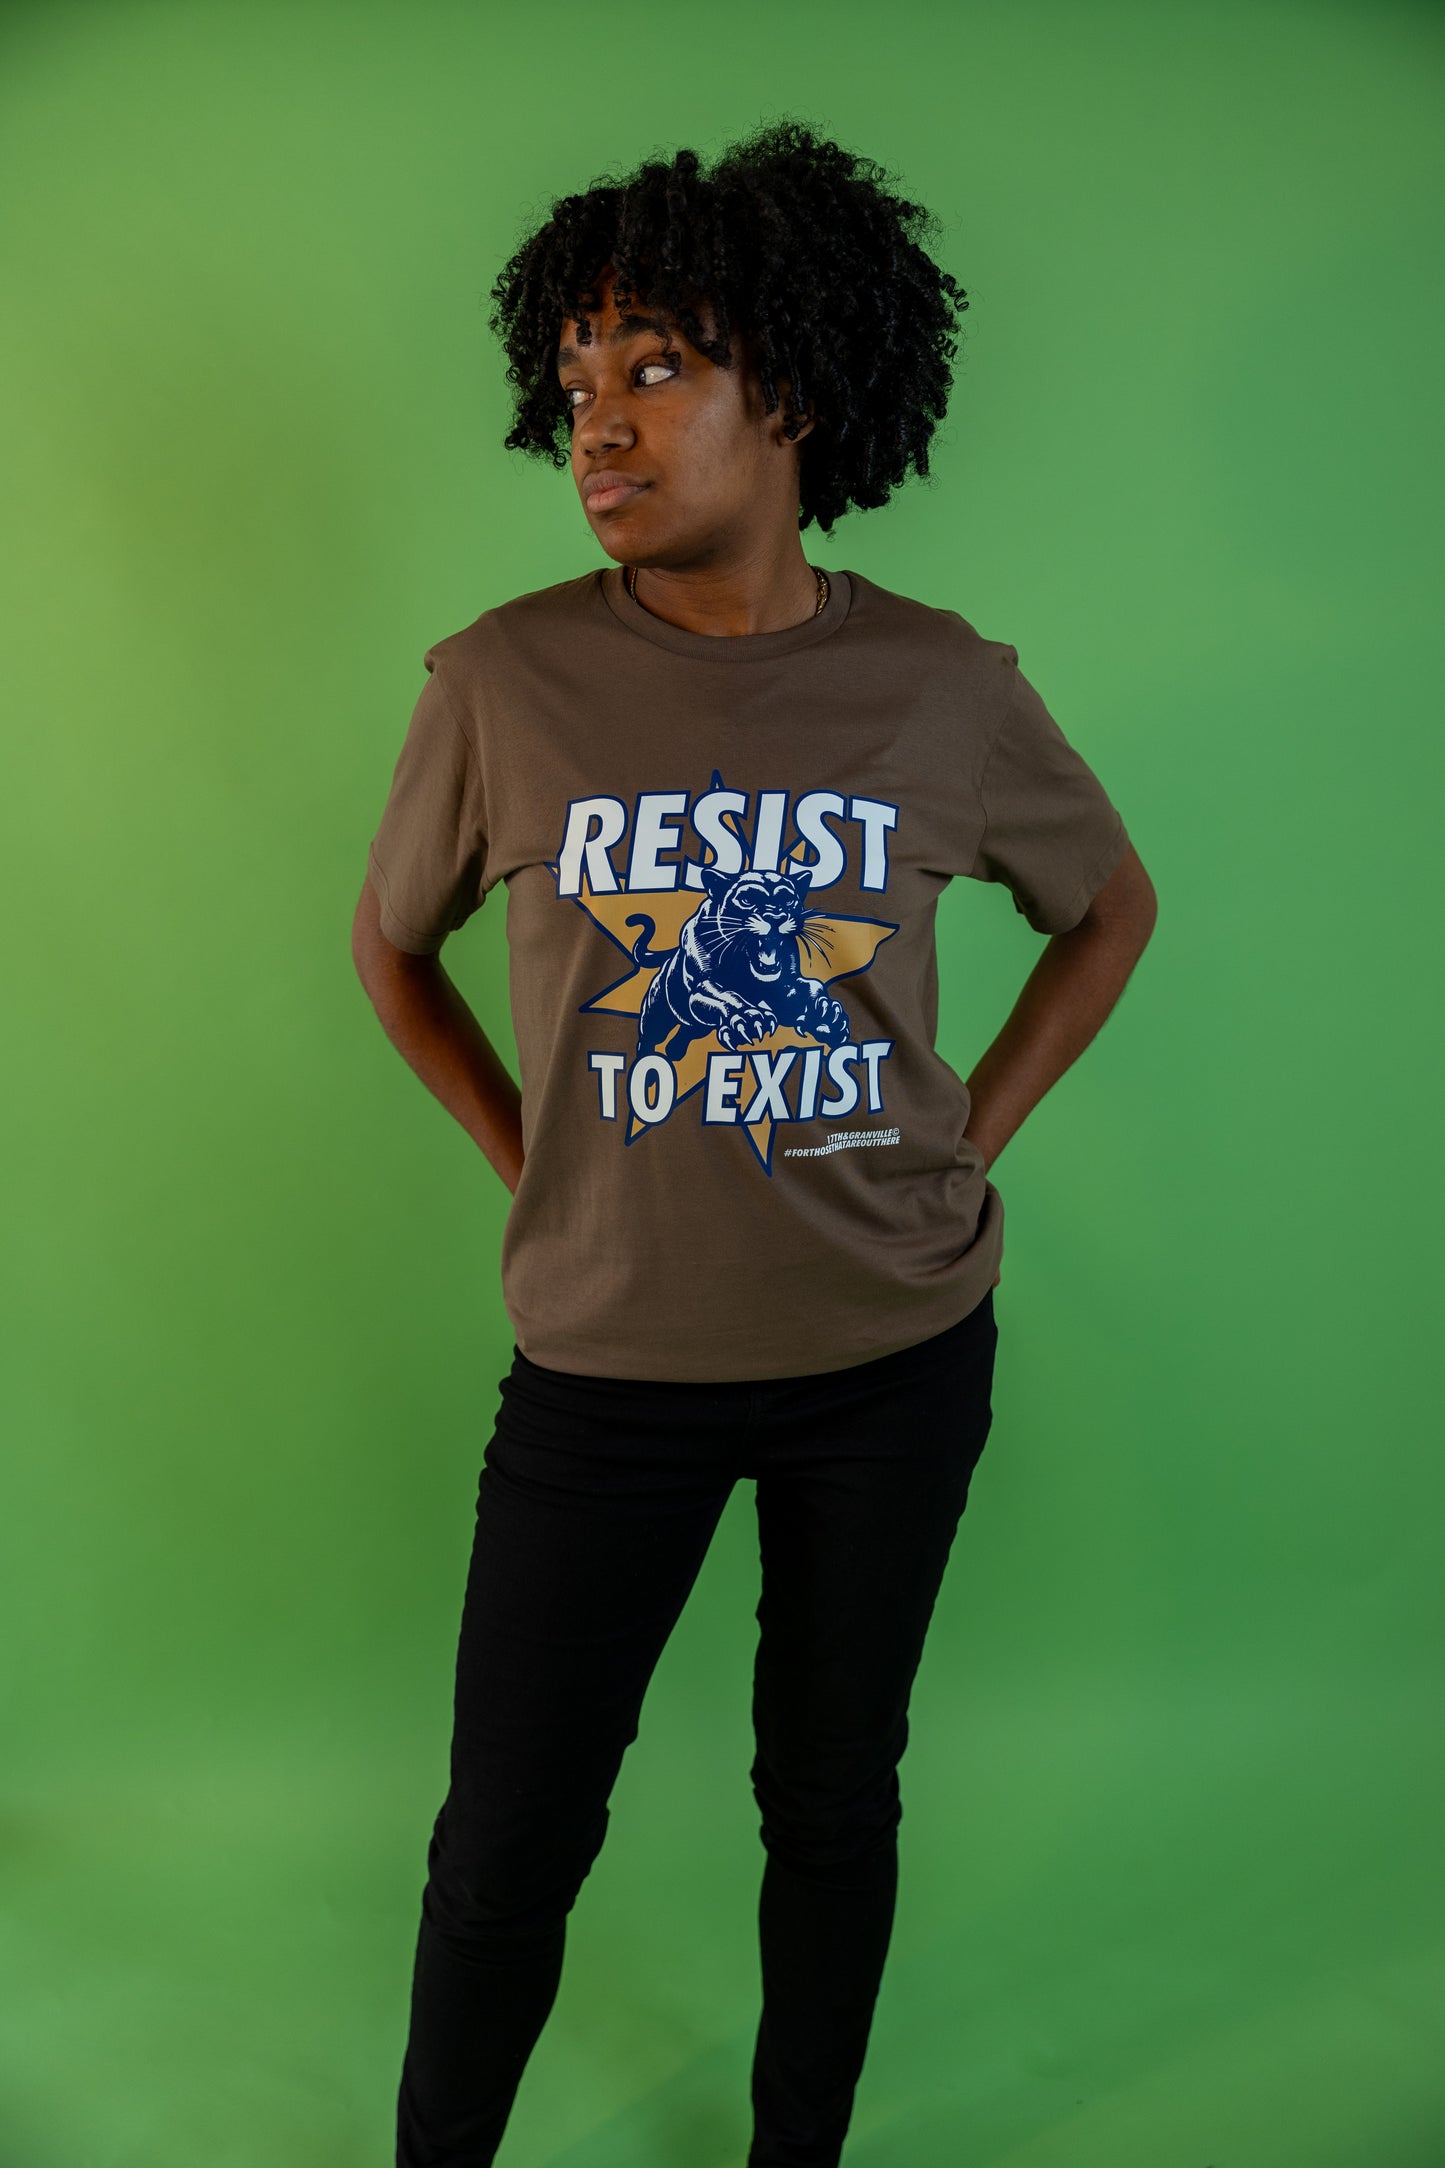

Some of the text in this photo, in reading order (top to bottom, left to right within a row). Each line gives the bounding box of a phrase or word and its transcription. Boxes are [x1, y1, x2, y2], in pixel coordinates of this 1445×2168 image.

[558, 790, 899, 896] RESIST
[589, 1040, 894, 1125] TO EXIST
[784, 1136, 900, 1157] #FORTHOSETHATAREOUTTHERE
